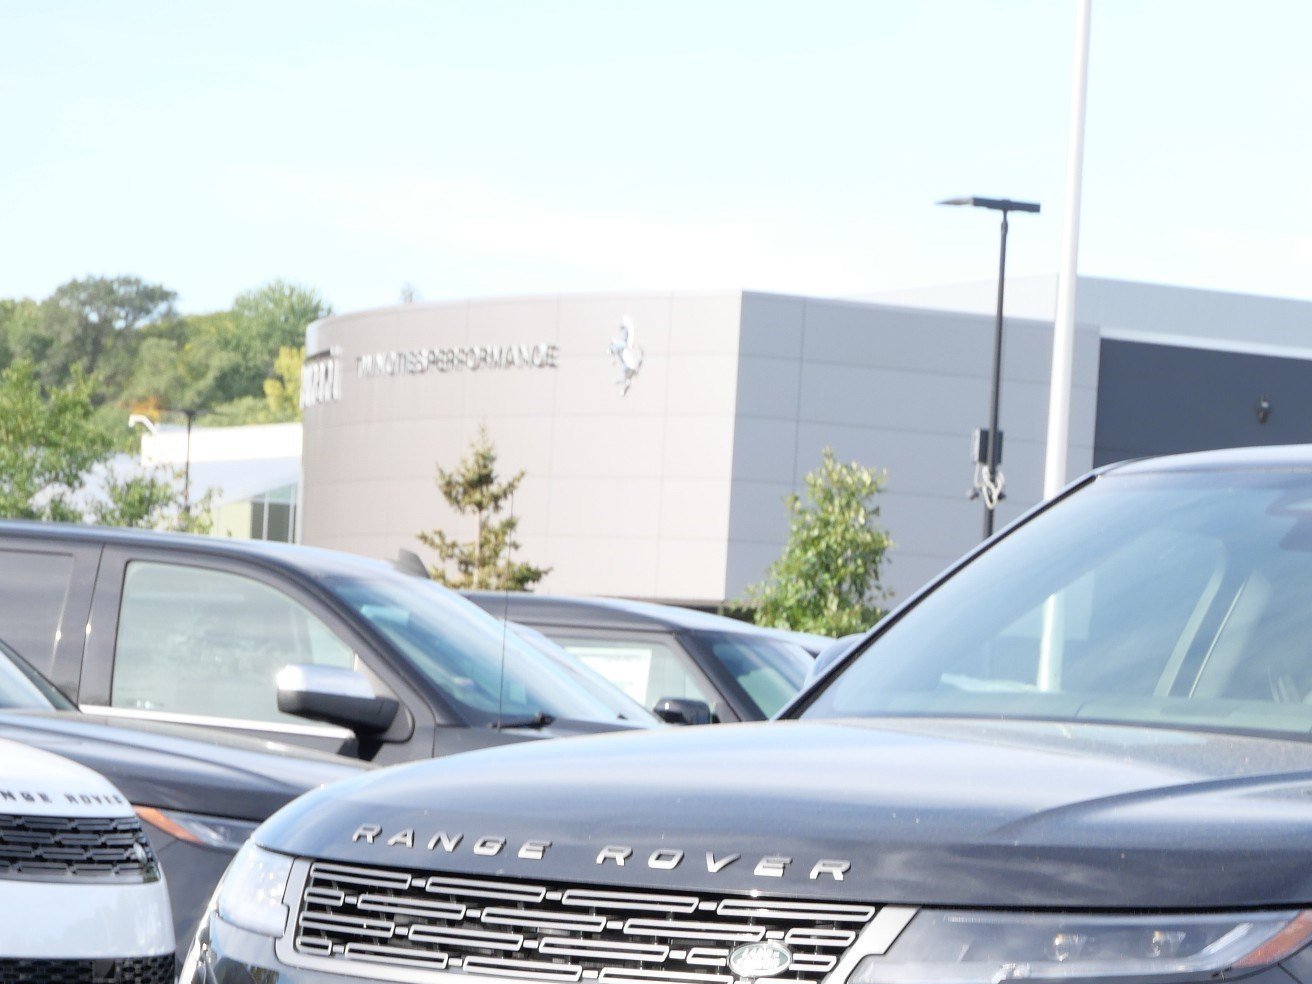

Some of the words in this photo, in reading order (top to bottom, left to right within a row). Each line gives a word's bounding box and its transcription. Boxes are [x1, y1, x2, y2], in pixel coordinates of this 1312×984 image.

[427, 343, 560, 373] PERFORMANCE
[351, 822, 553, 860] RANGE
[596, 844, 852, 881] ROVER
